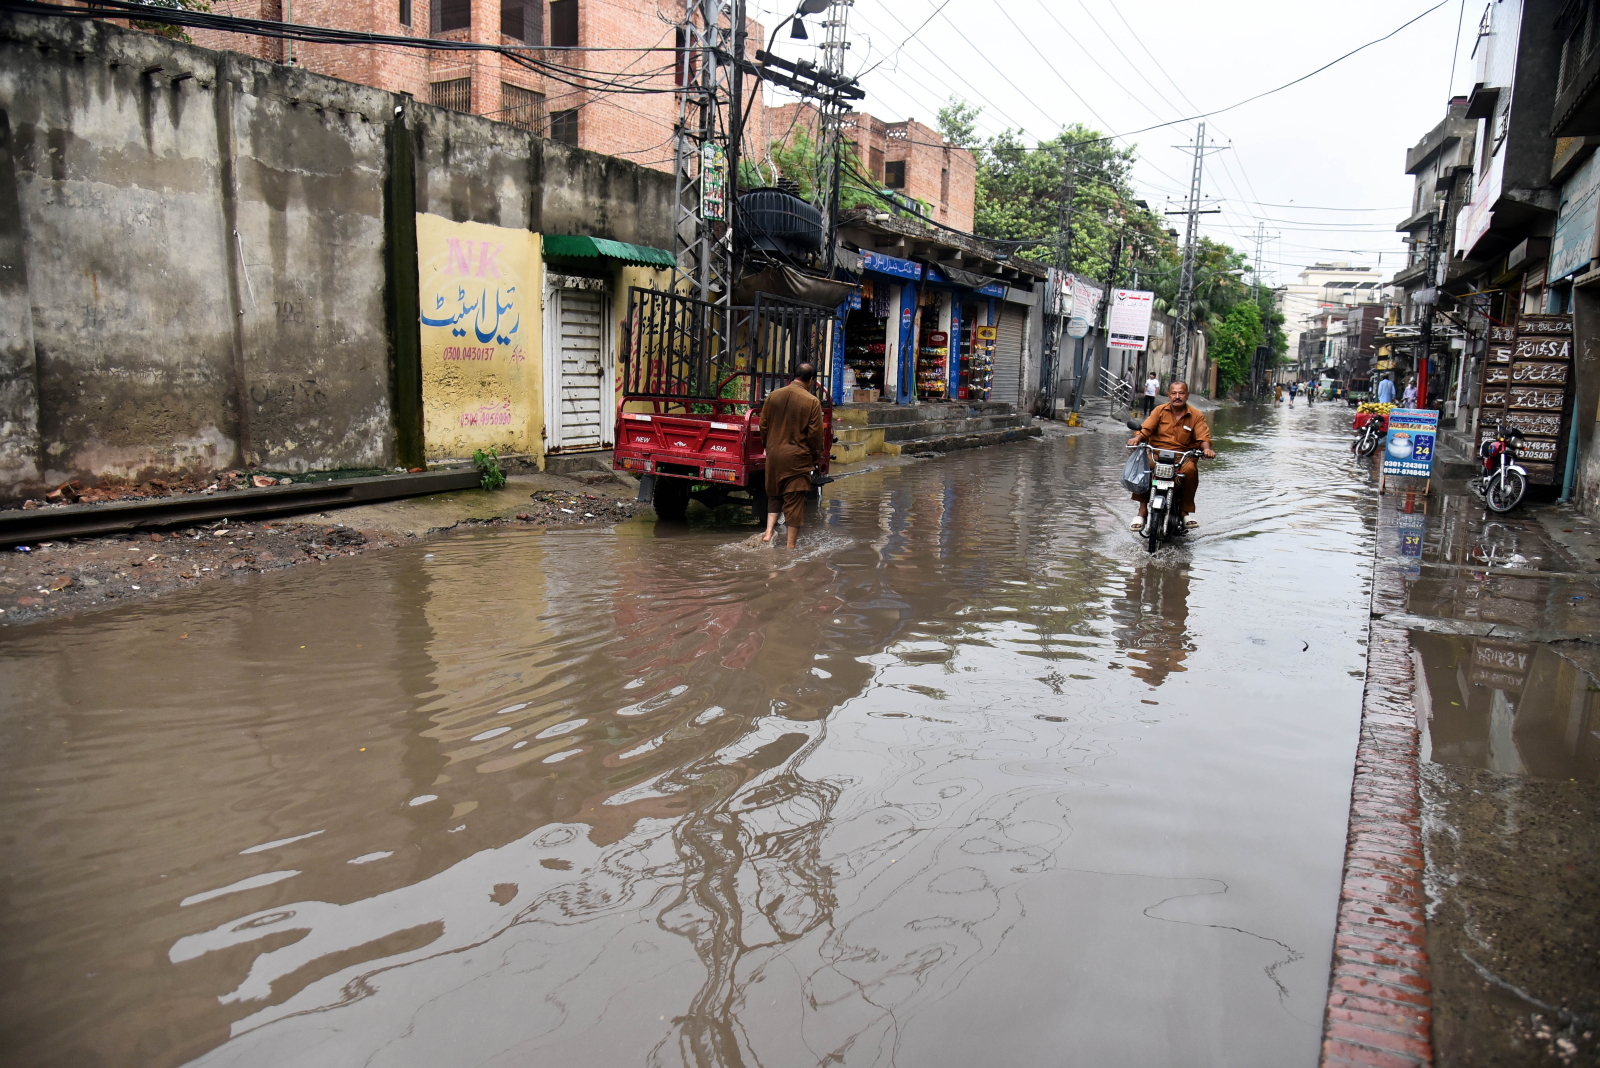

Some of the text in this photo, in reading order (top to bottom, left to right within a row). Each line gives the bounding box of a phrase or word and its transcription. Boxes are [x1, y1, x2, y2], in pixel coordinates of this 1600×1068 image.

[444, 237, 505, 279] NK
[443, 346, 495, 361] 0300.0430137
[710, 444, 727, 452] ASIA
[1415, 446, 1430, 455] 24
